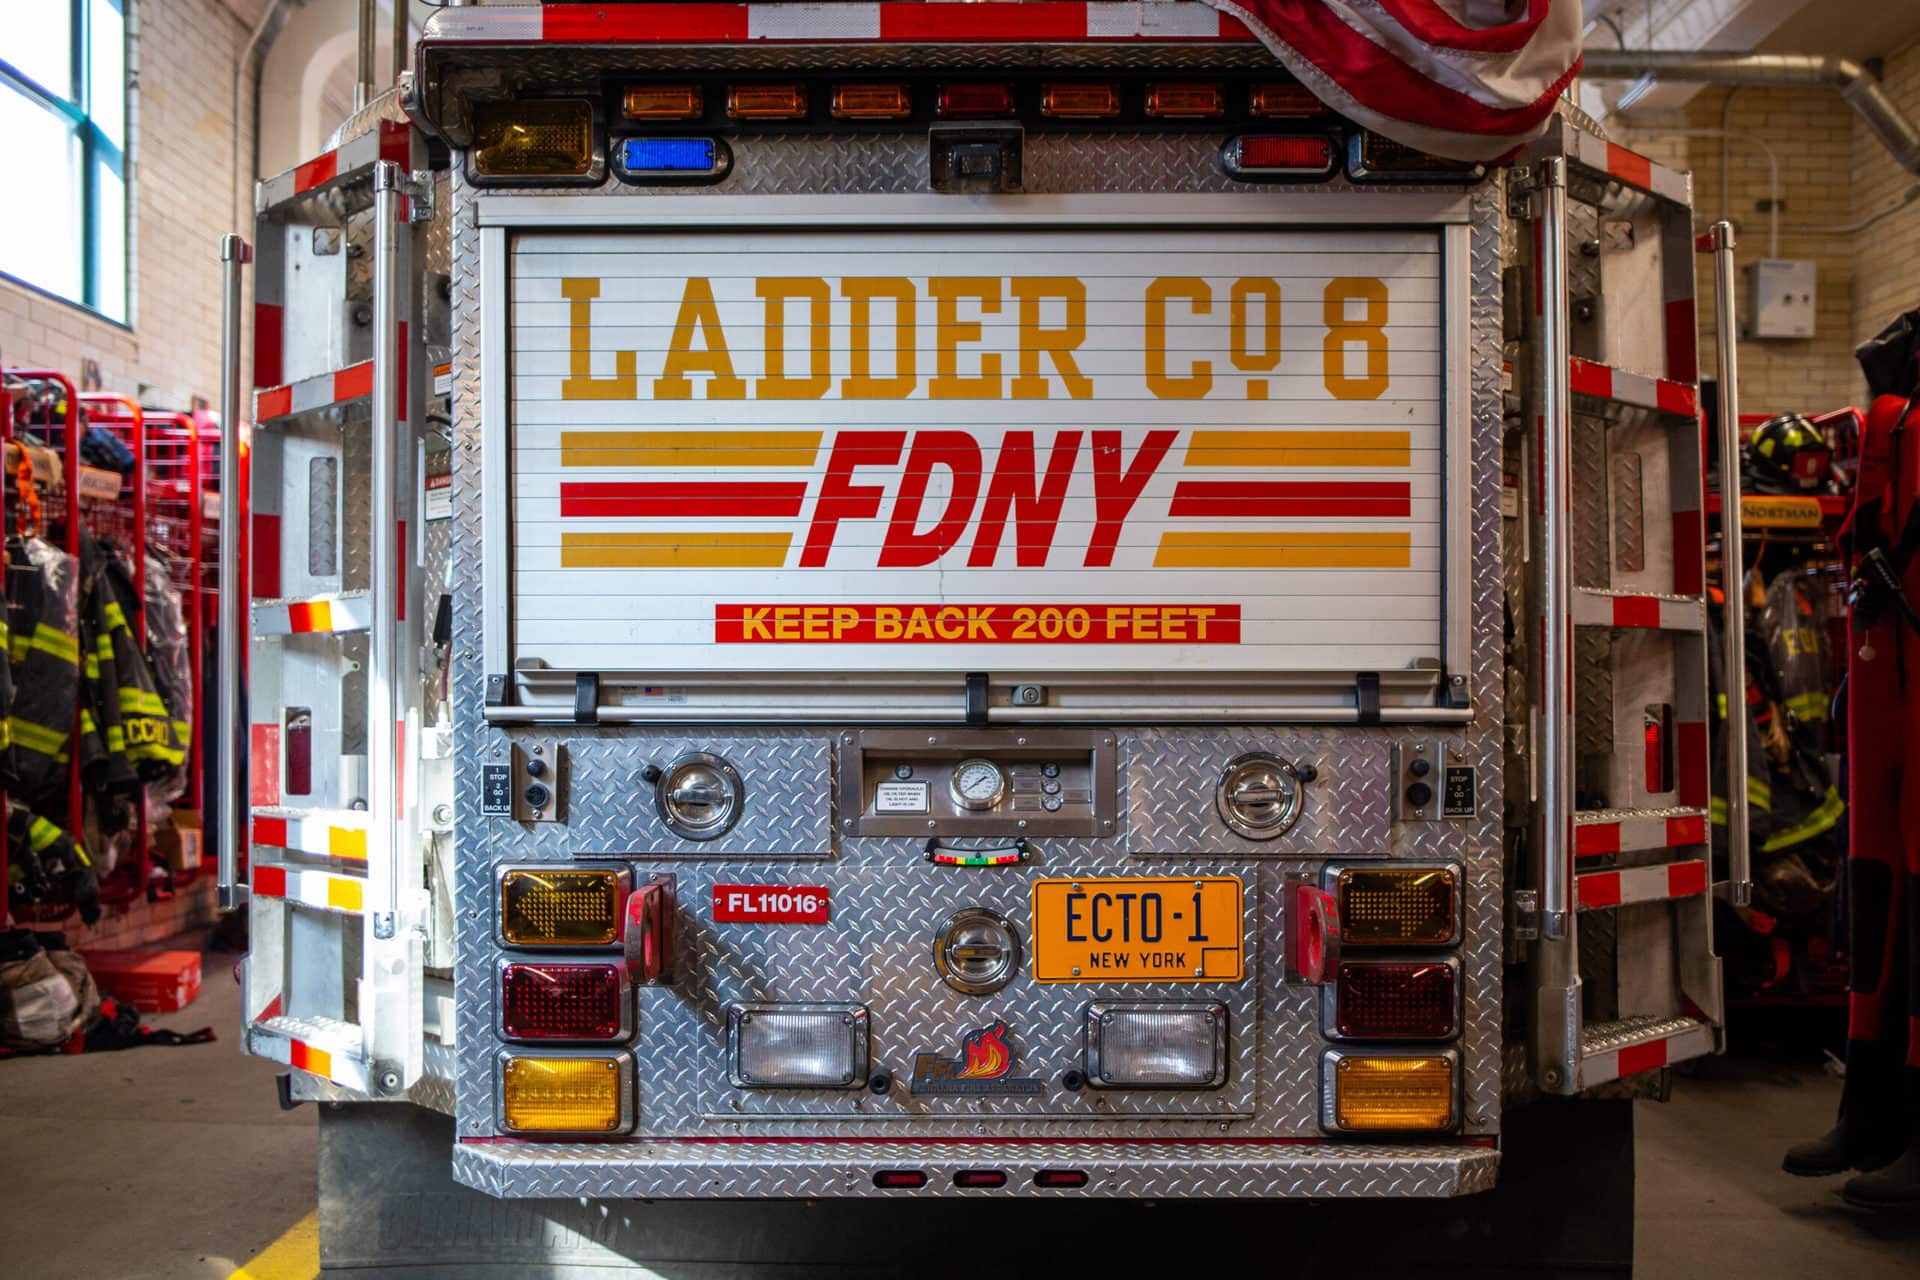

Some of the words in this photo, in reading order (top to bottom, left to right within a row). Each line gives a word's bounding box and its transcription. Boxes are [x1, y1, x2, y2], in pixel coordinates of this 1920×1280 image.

[562, 277, 1092, 400] LADDER
[1324, 277, 1389, 400] 8
[798, 431, 1180, 567] FDNY
[743, 607, 859, 640] KEEP
[875, 607, 996, 640] BACK
[1012, 607, 1090, 640] 200
[1106, 607, 1216, 640] FEET
[728, 893, 818, 914] FL11016
[1066, 892, 1209, 943] ECTO-1
[1090, 952, 1130, 968] NEW
[1140, 952, 1186, 968] YORK
